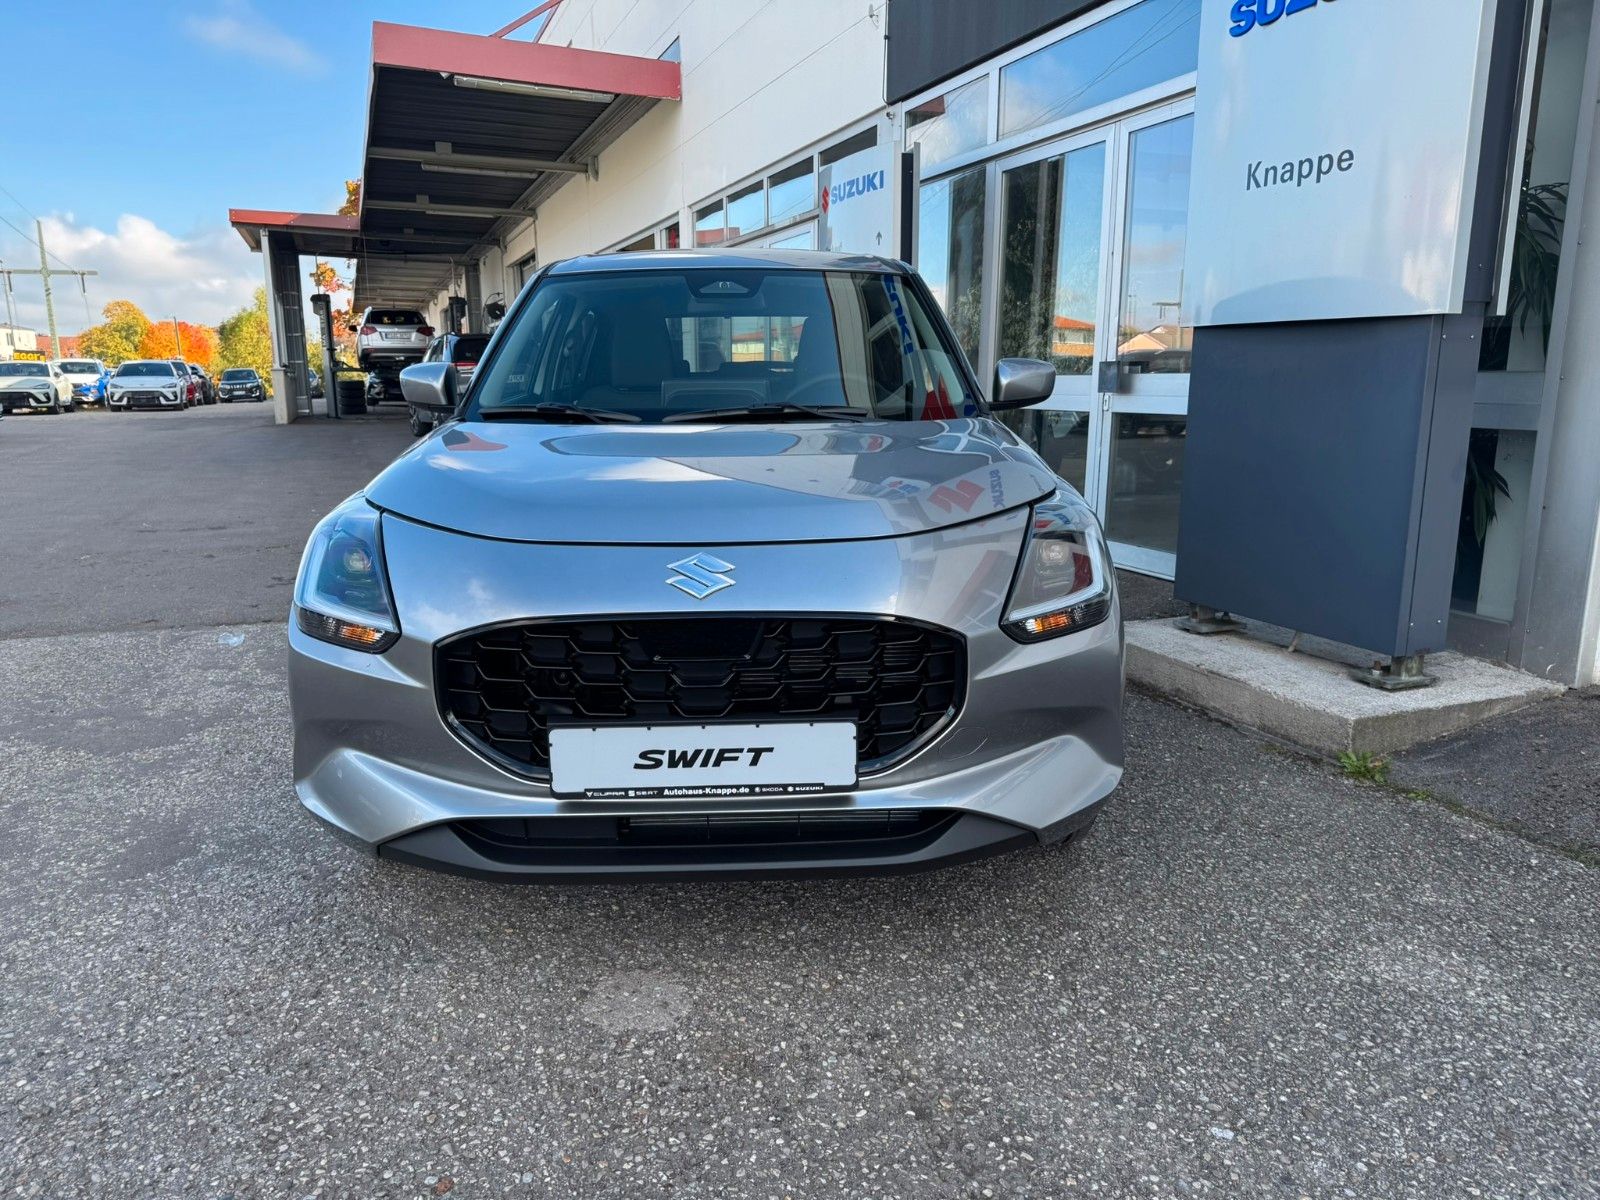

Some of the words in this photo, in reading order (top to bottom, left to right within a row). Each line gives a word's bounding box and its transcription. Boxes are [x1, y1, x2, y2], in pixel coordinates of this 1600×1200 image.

[1229, 0, 1337, 38] SU
[1246, 148, 1355, 191] Knappe
[830, 170, 884, 205] SUZUKI
[633, 747, 775, 770] SWIFT
[663, 787, 750, 796] Autohaus-Knappe.de
